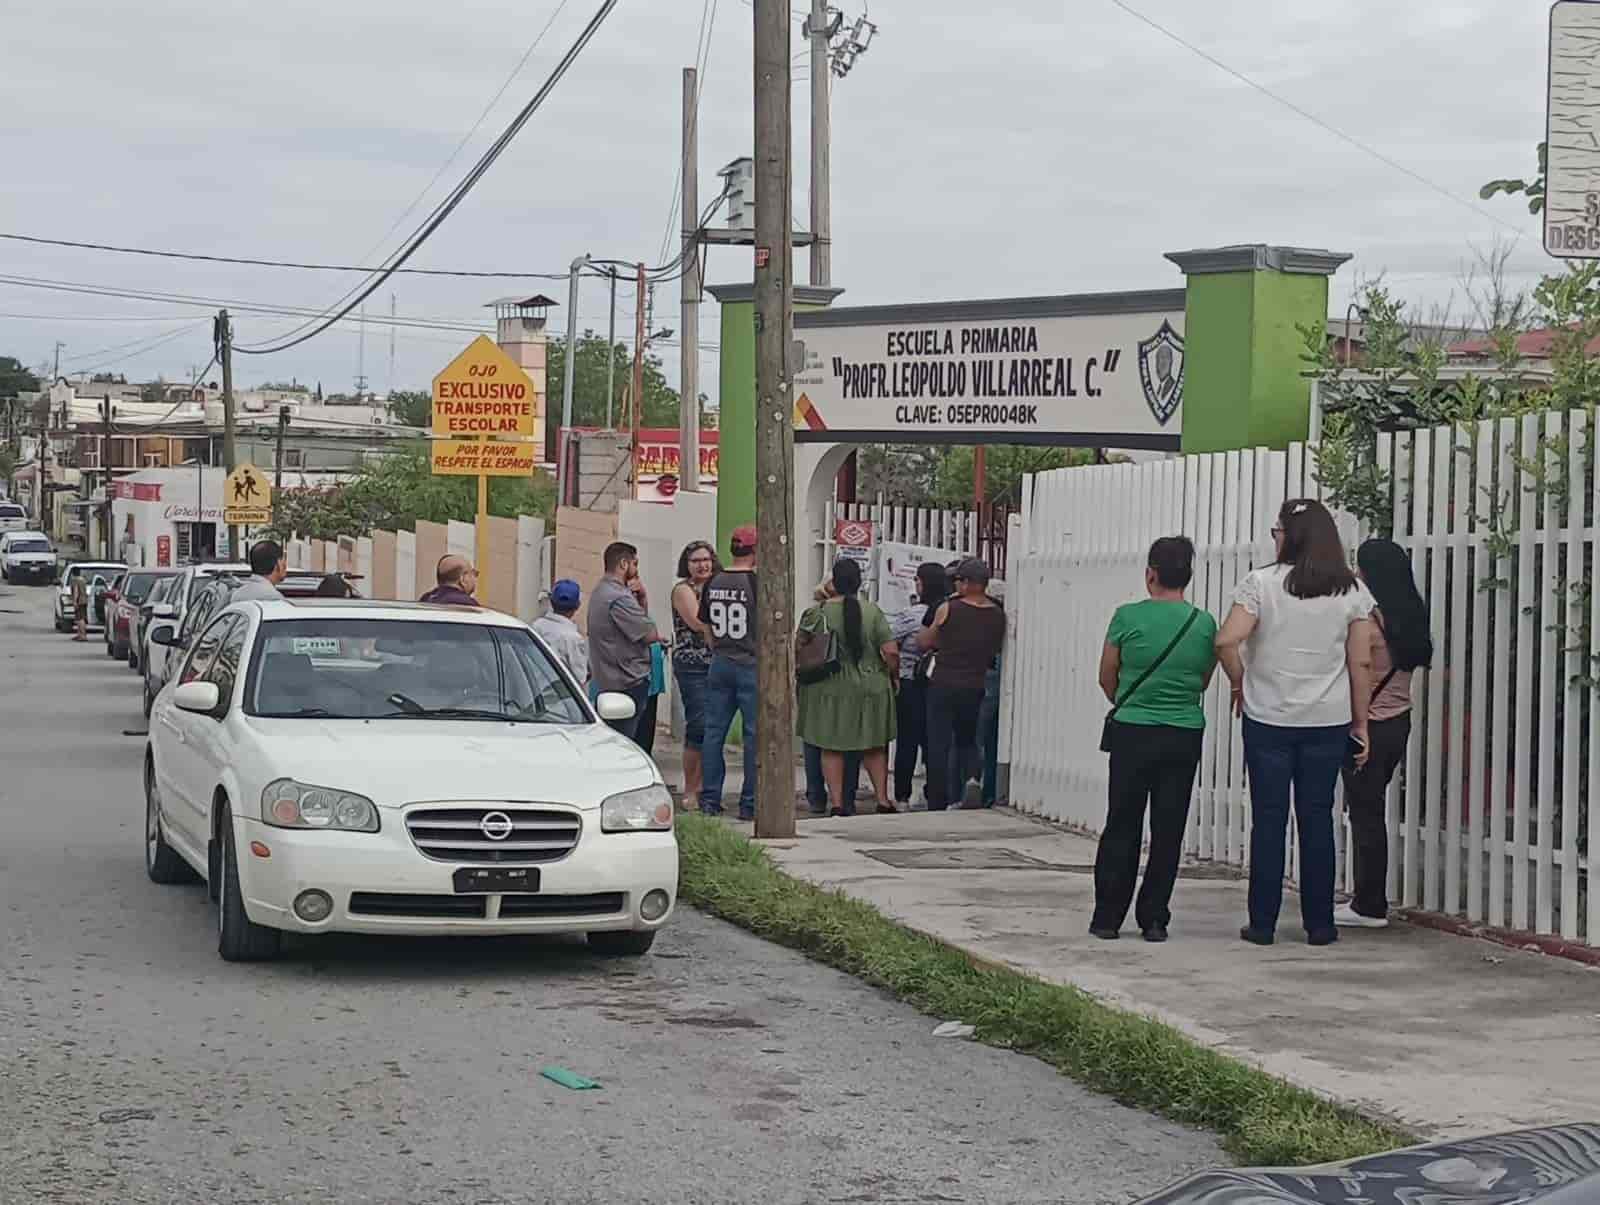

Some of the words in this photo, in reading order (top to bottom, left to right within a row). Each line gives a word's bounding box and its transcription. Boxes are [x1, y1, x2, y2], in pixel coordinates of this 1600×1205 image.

[887, 329, 954, 356] ESCUELA
[961, 327, 1038, 354] PRIMARIA
[469, 365, 497, 377] OJO
[892, 360, 966, 398] LEOPOLDO
[972, 358, 1077, 397] VILLARREAL
[439, 382, 526, 399] EXCLUSIVO
[434, 401, 531, 416] TRANSPORTE
[895, 404, 942, 424] CLAVE:
[448, 418, 518, 432] ESCOLAR
[456, 444, 479, 455] POR
[481, 444, 517, 457] FAVOR
[434, 456, 480, 468] RESPETE
[481, 457, 493, 468] EL
[495, 458, 533, 469] ESPACIO
[228, 512, 265, 520] TERMINA
[710, 601, 748, 640] 98
